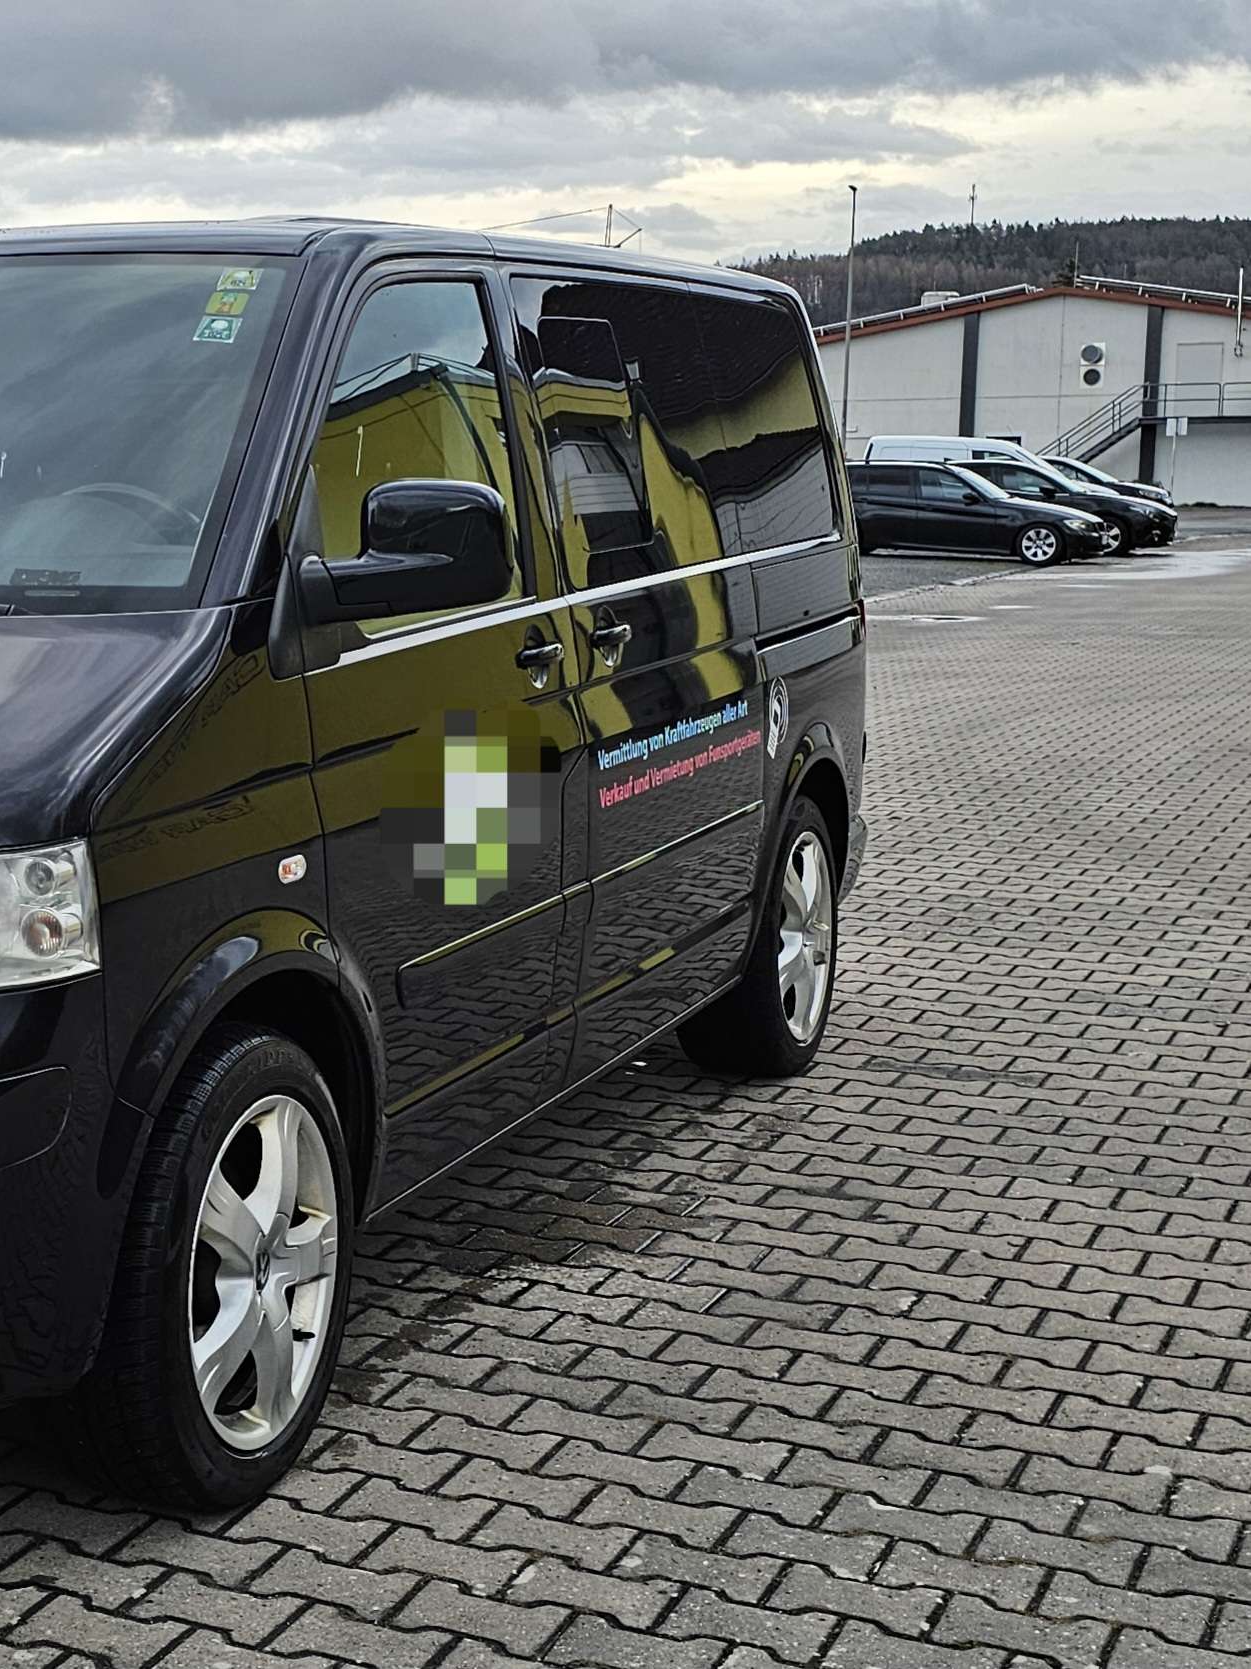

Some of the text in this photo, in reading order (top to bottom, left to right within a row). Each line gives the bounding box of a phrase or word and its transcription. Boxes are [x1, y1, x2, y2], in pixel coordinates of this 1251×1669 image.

[597, 699, 748, 770] Vermittlung von Kraftfahrzeugen aller Art
[599, 775, 633, 808] Verkauf
[633, 769, 650, 795] und
[650, 758, 694, 788] Vermietung
[694, 751, 708, 769] von
